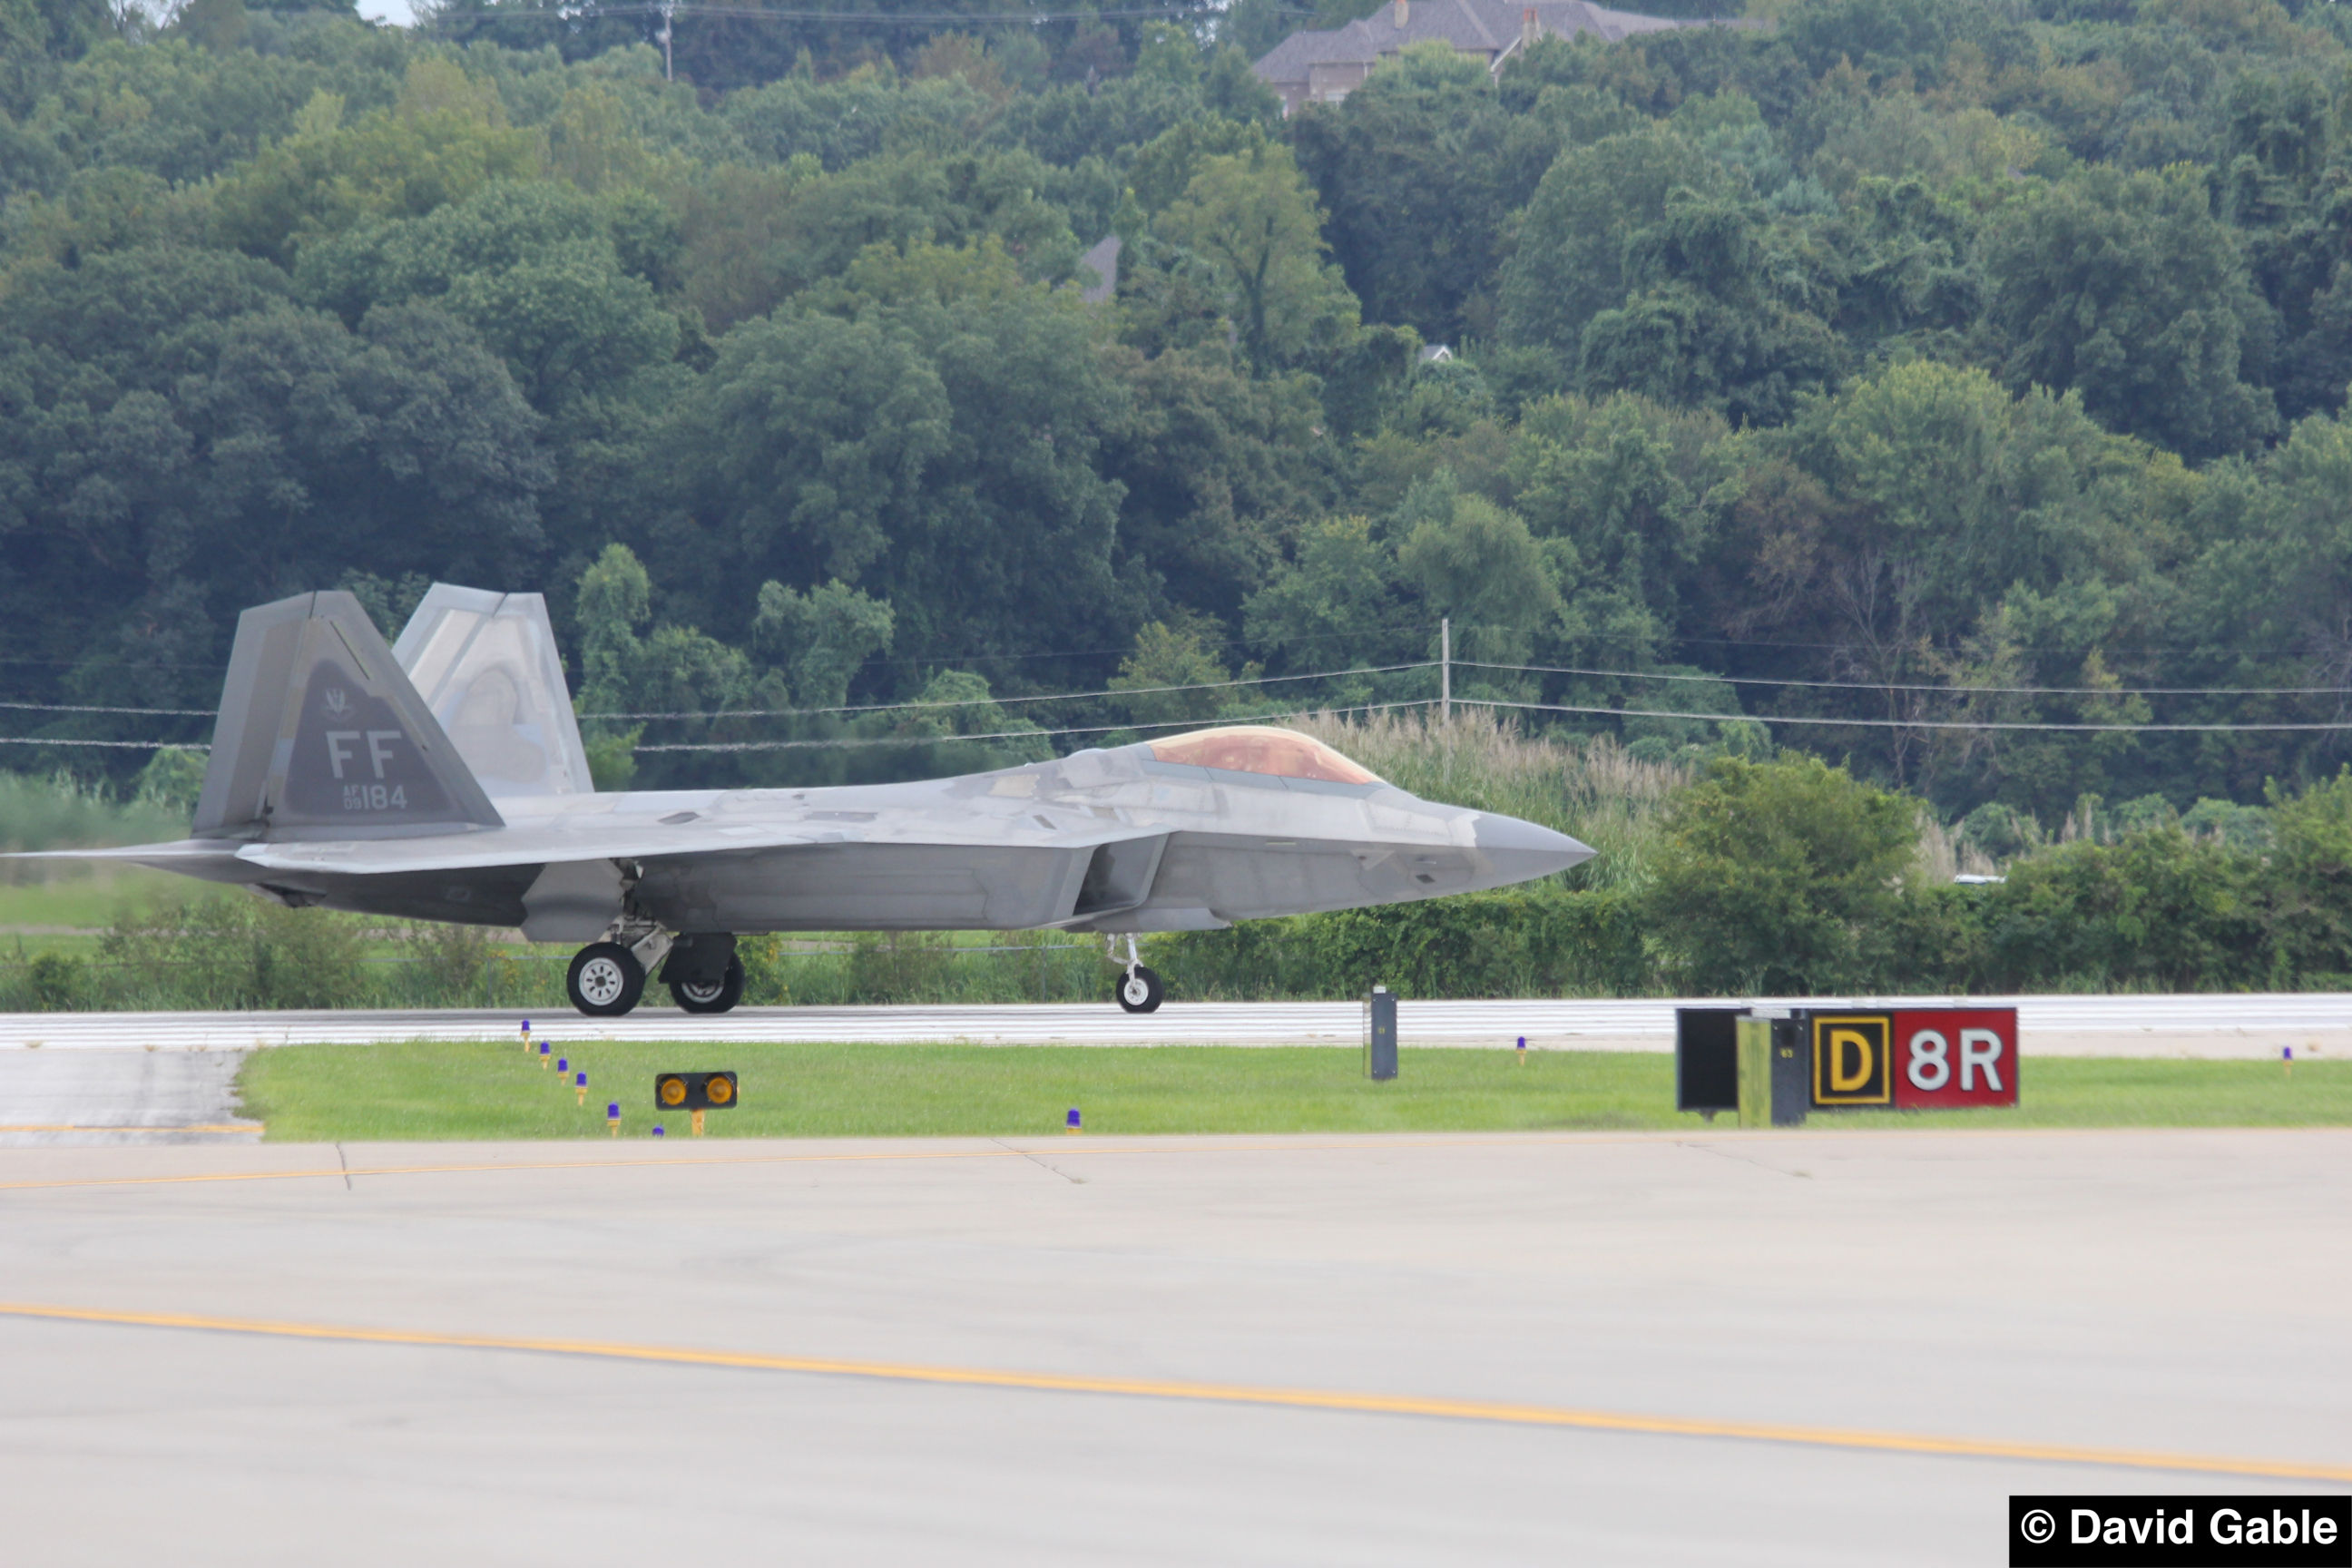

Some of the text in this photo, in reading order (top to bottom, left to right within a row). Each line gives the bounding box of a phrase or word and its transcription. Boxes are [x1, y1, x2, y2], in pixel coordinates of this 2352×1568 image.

[326, 730, 402, 779] FF
[344, 785, 358, 797] AF
[344, 797, 362, 809] 09
[362, 785, 407, 809] 184
[1829, 1028, 2003, 1092] D 8R
